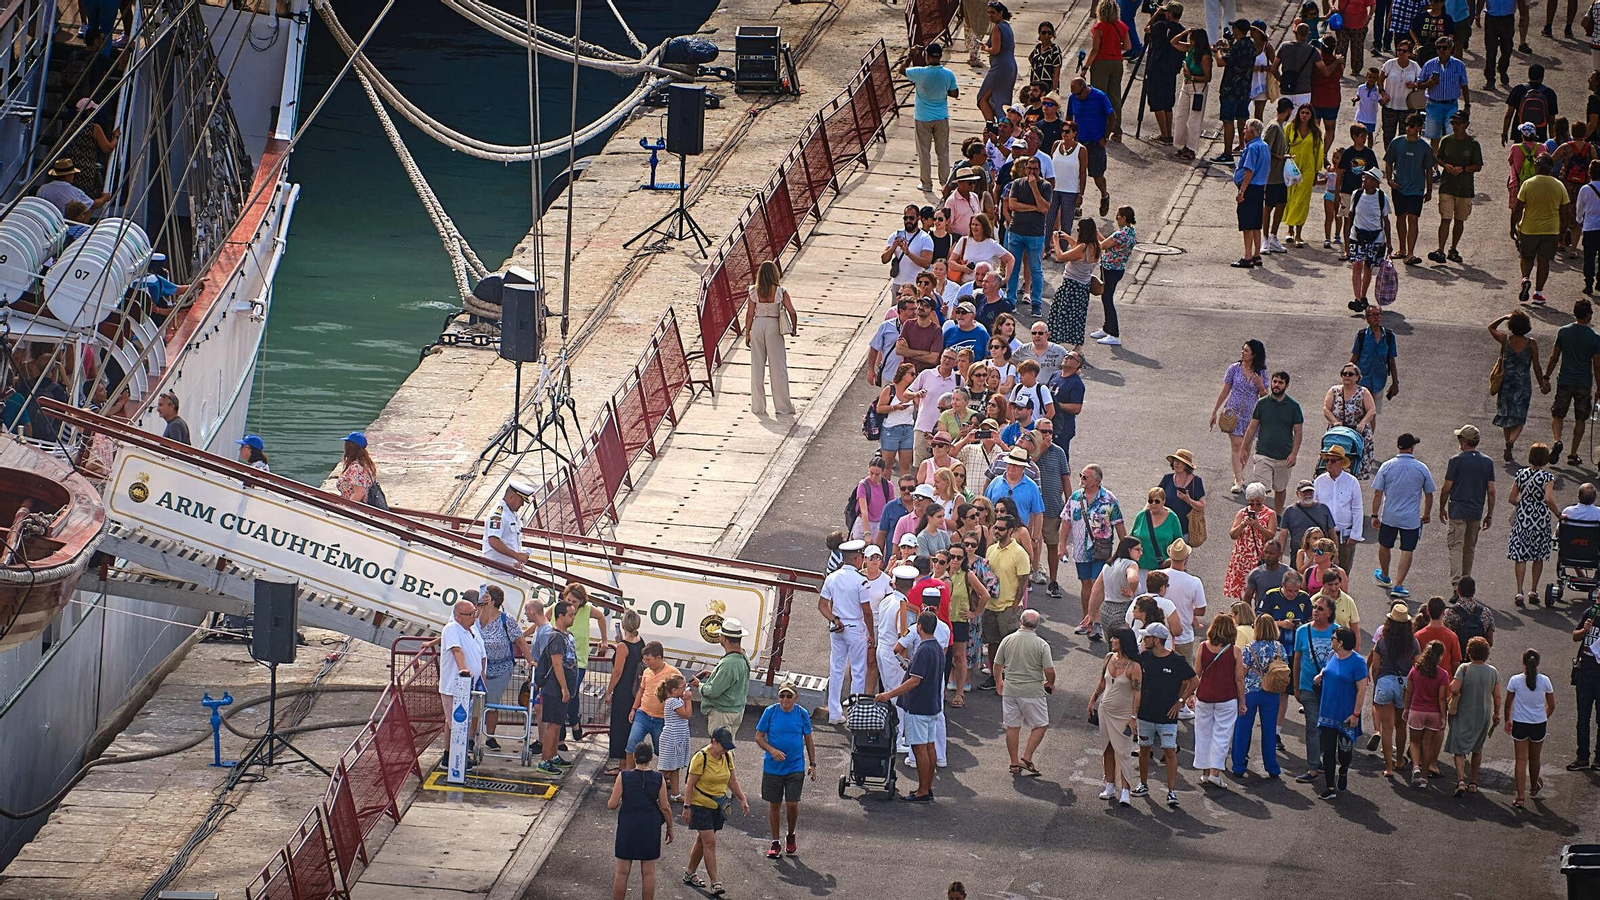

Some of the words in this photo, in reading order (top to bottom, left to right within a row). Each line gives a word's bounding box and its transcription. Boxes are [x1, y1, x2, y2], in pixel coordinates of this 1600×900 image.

[75, 269, 90, 280] 07
[155, 491, 217, 524] ARM
[219, 512, 397, 586] CUAUHTÉMOC
[399, 573, 466, 606] BE-0
